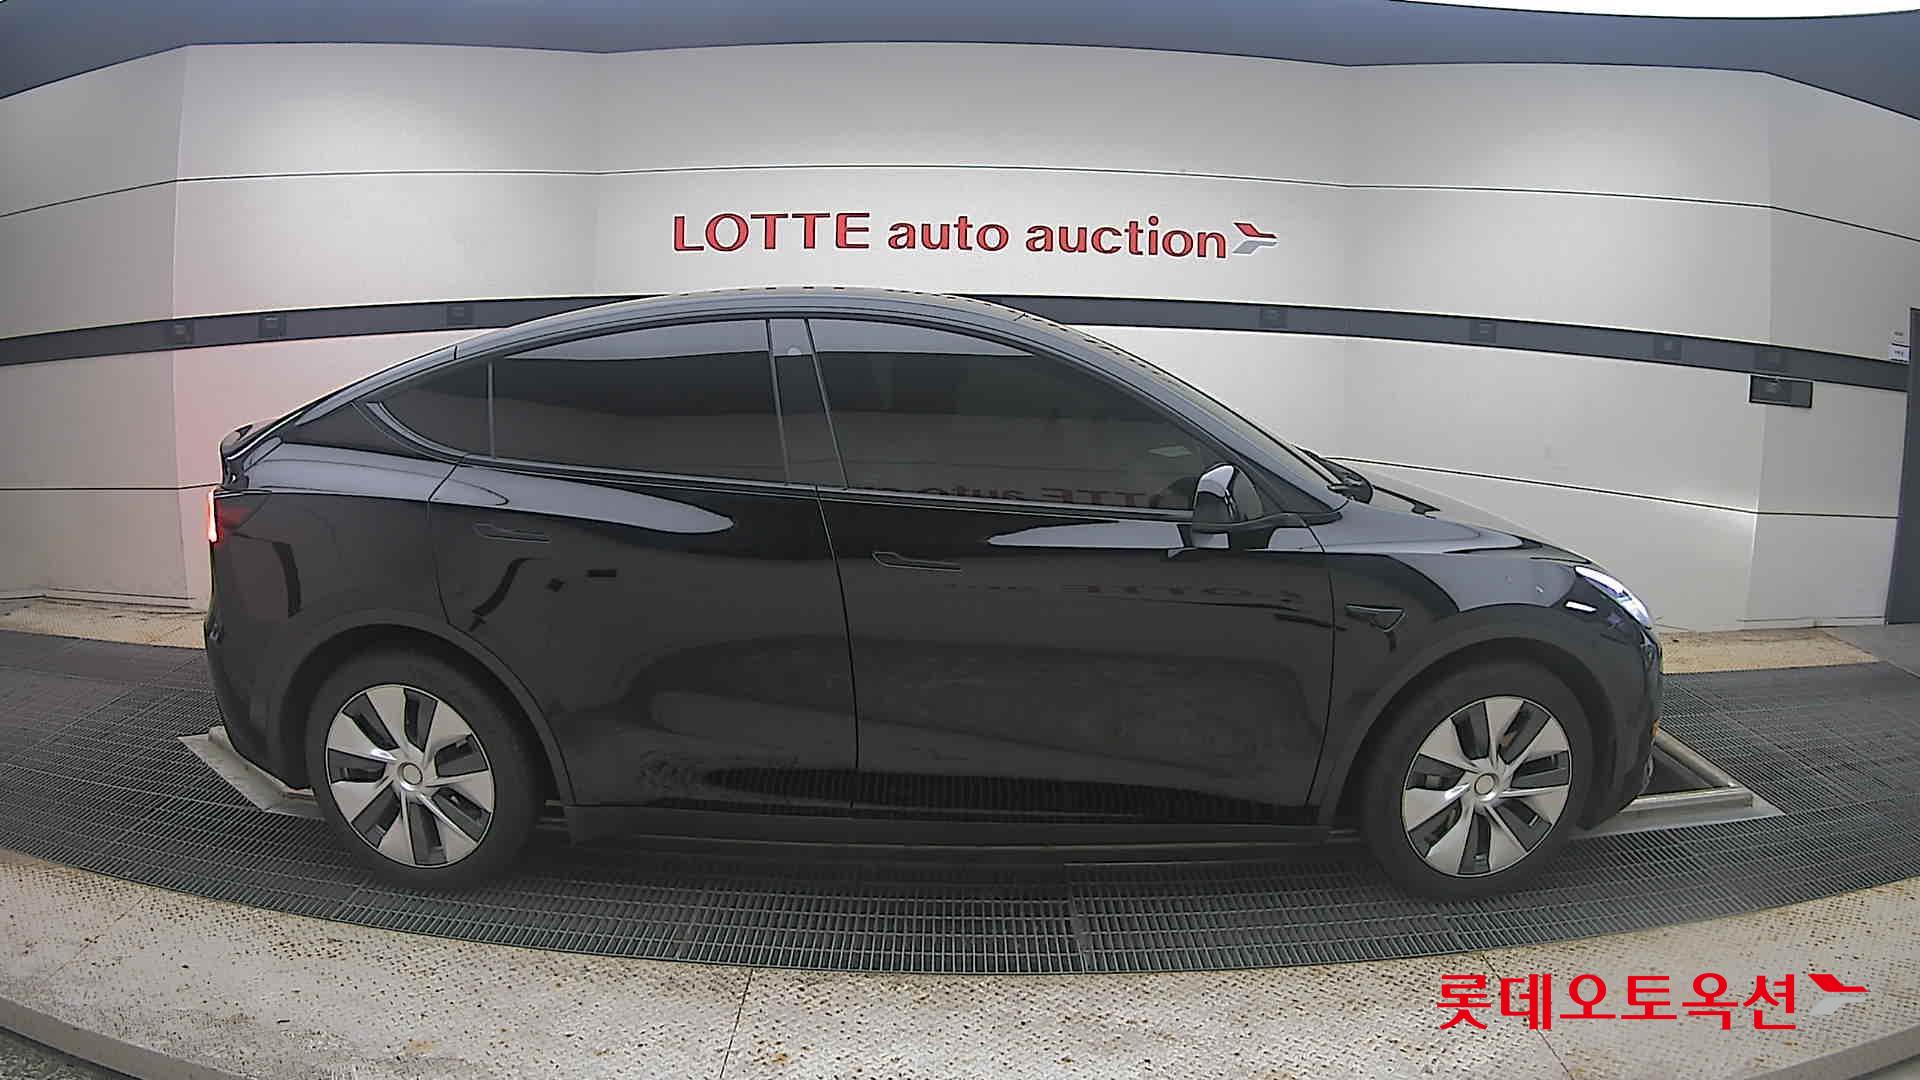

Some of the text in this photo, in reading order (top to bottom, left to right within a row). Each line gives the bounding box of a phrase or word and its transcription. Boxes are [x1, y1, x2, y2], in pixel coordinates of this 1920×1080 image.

[673, 211, 1227, 258] LOTTE auto auction
